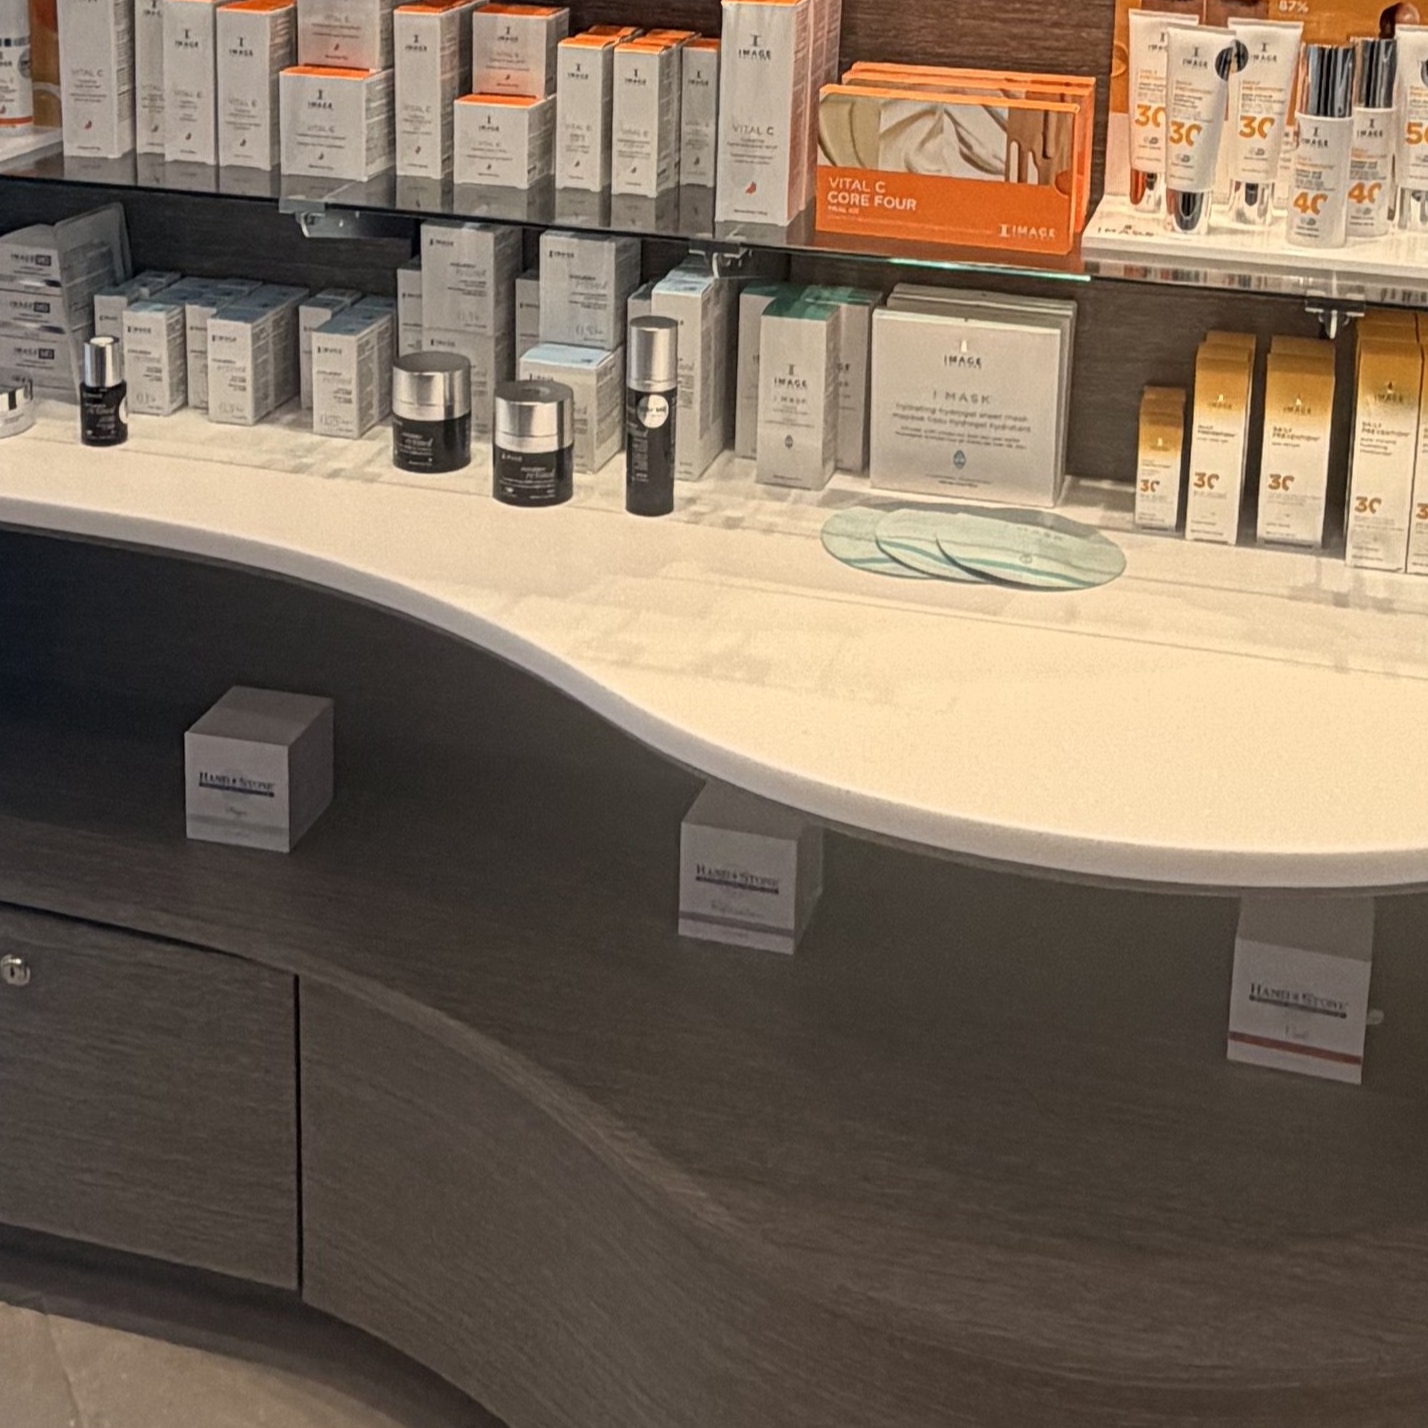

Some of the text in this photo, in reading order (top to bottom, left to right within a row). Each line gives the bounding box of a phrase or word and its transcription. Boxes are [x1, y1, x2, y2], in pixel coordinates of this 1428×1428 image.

[1277, 0, 1310, 13] 87%
[737, 48, 772, 58] IMAGE
[731, 124, 763, 136] VITAL
[828, 176, 887, 195] VITAL C
[827, 190, 917, 212] CORE FOUR
[1012, 225, 1057, 239] IMAGE
[943, 354, 983, 370] IMAGE
[773, 376, 808, 389] IMAGE
[944, 391, 992, 406] MASK
